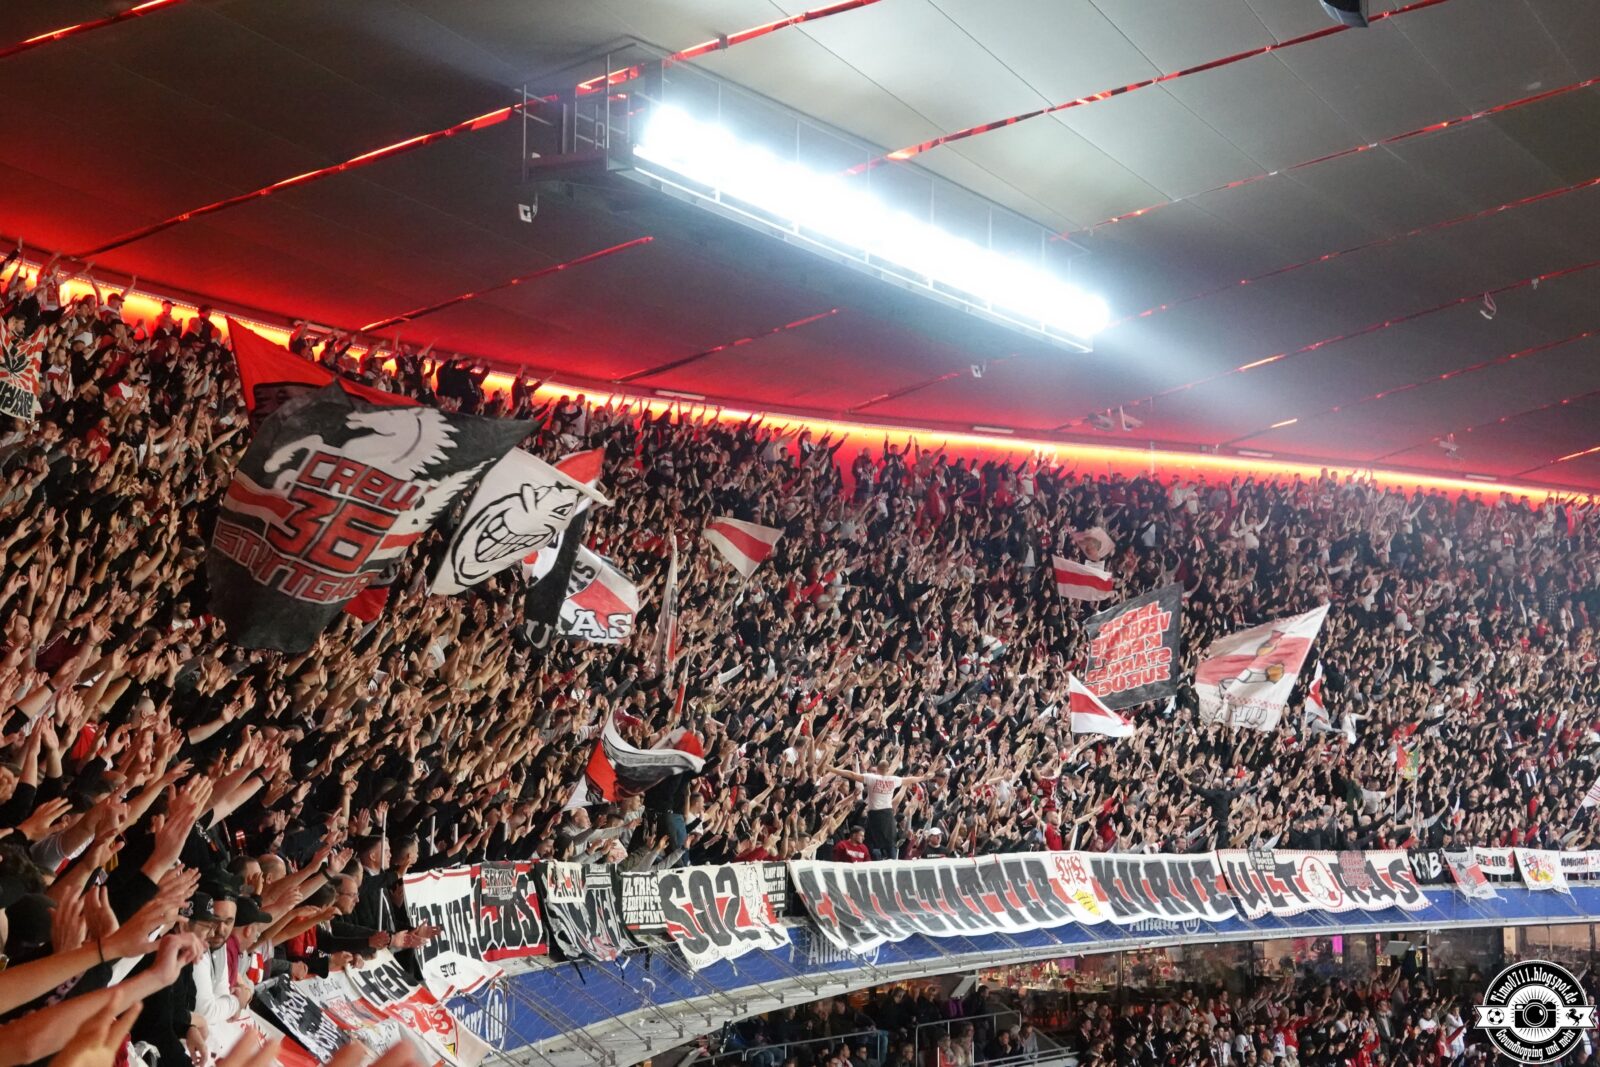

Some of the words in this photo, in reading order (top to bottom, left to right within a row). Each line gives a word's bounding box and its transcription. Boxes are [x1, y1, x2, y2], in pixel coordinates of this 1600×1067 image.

[265, 486, 399, 574] 36
[622, 876, 659, 896] ULTRAS
[1091, 858, 1236, 917] KURVE
